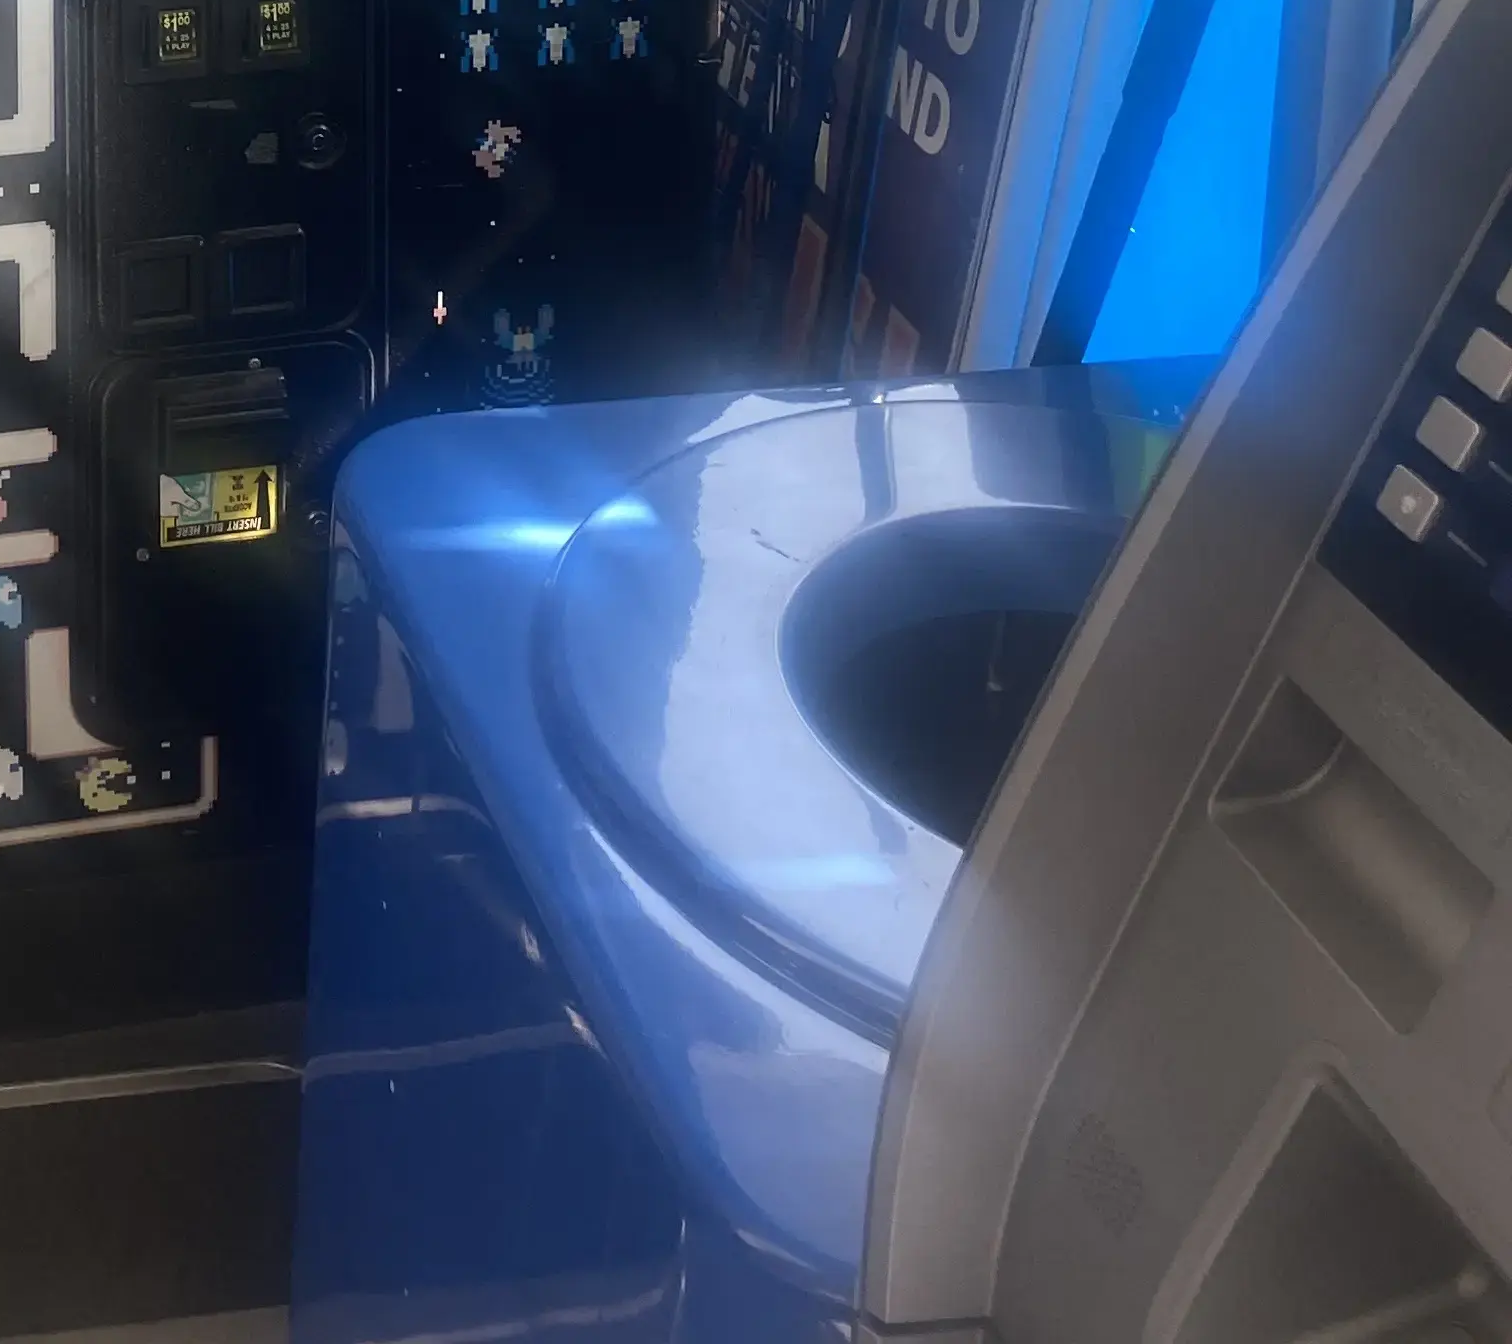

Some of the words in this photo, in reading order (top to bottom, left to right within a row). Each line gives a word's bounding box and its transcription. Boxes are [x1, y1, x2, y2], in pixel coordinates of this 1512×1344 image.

[204, 522, 225, 533] BILL
[226, 516, 262, 531] INSERT
[175, 526, 201, 538] HERE
